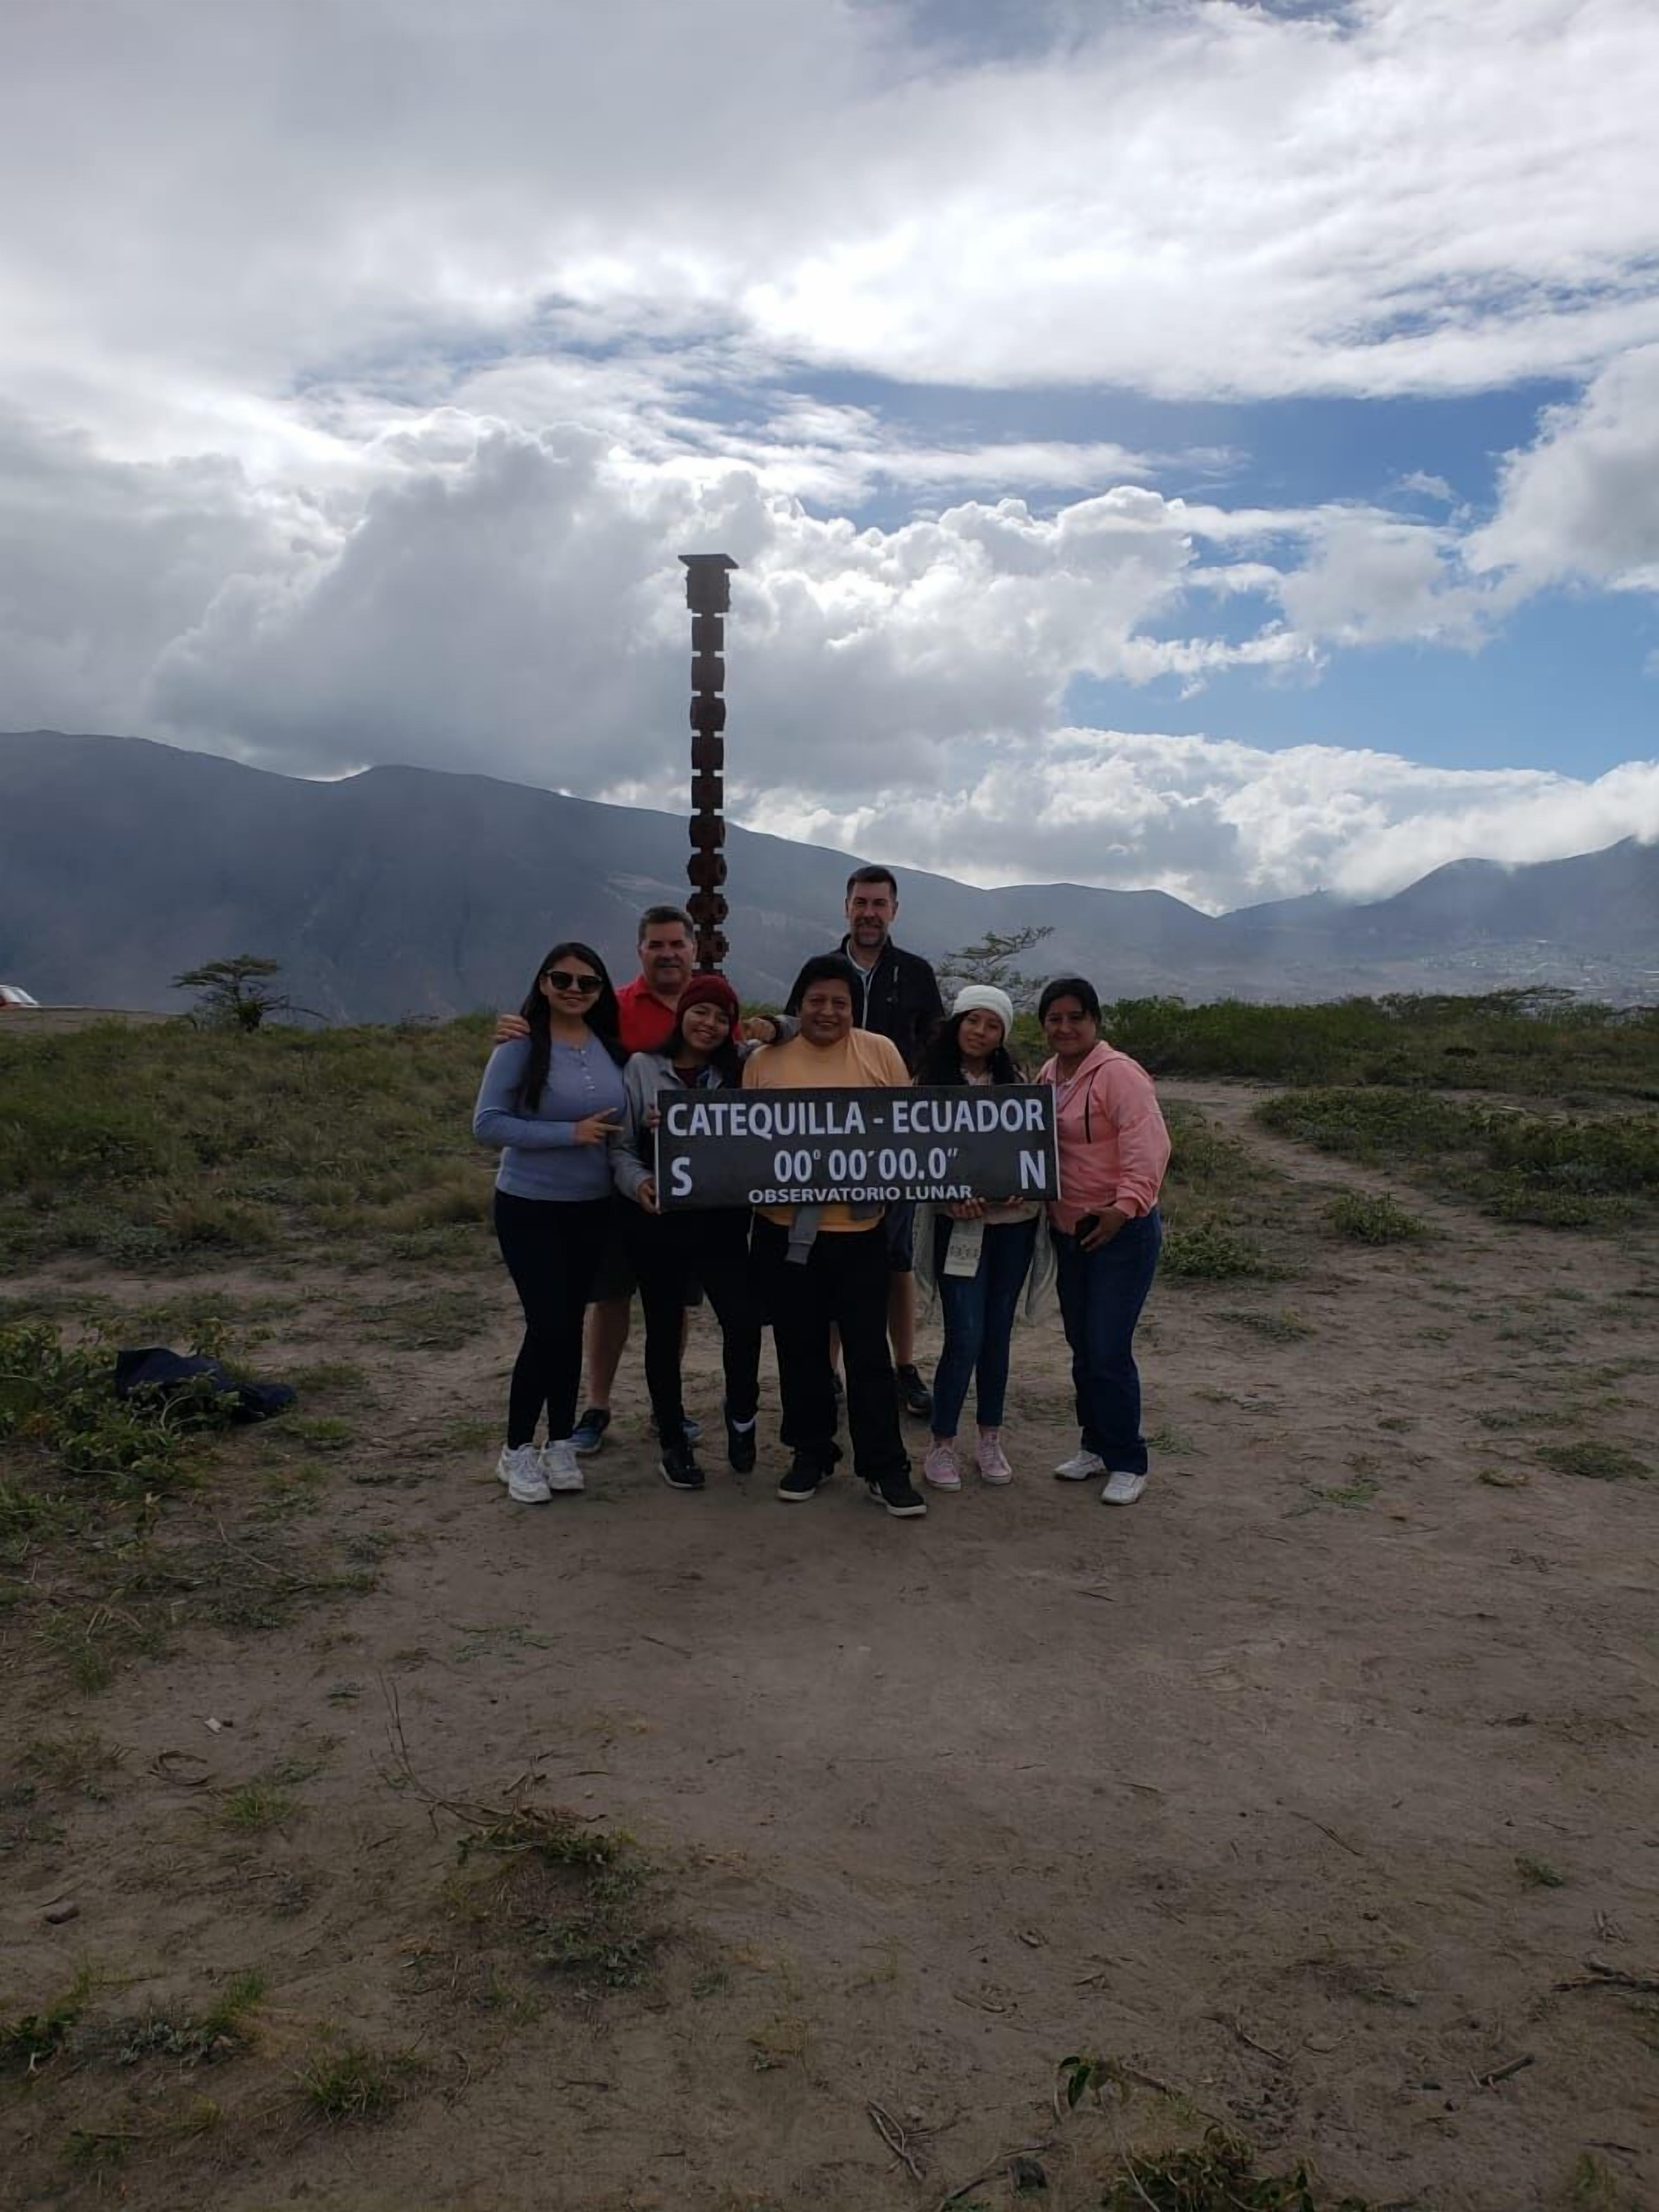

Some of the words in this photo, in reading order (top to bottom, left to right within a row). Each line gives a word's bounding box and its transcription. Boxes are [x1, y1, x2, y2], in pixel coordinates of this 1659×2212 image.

[667, 1101, 866, 1141] CATEQUILLA
[892, 1099, 1046, 1134] ECUADOR
[671, 1157, 693, 1196] S
[1019, 1150, 1046, 1189] N
[748, 1187, 901, 1204] OBSERVATORIO
[906, 1185, 972, 1201] LUNAR
